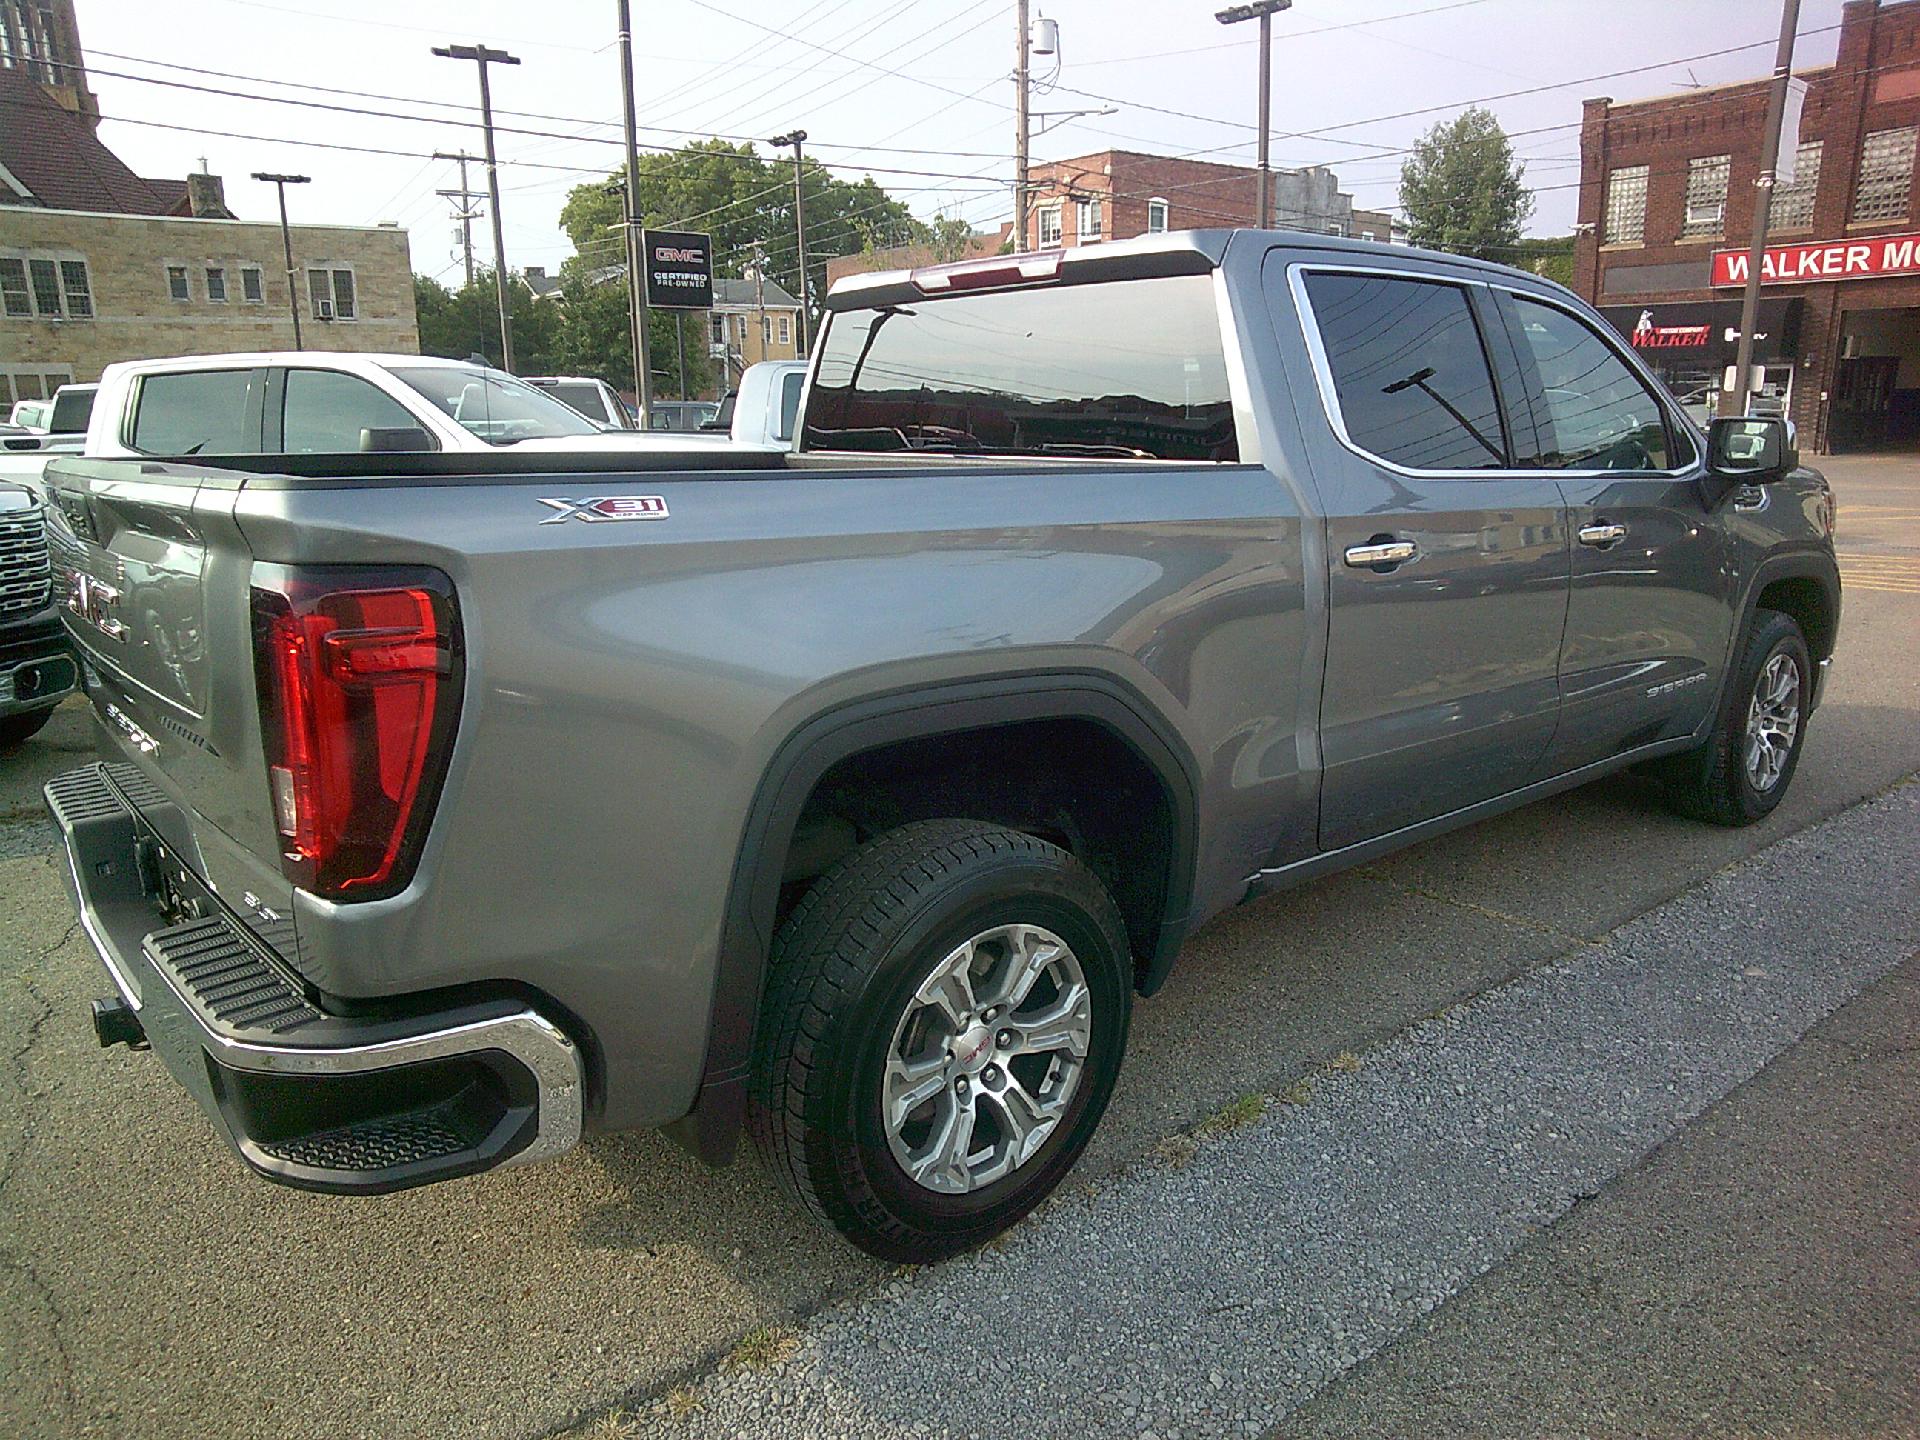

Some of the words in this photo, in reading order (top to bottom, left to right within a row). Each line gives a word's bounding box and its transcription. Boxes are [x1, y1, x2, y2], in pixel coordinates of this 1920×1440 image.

[655, 247, 704, 263] GMC
[1727, 246, 1871, 280] WALKER
[1882, 240, 1920, 269] M
[654, 272, 708, 281] CERTIFIED
[657, 280, 705, 288] PRE-OWNED
[1631, 329, 1708, 347] WALKER
[963, 1035, 991, 1065] GMC
